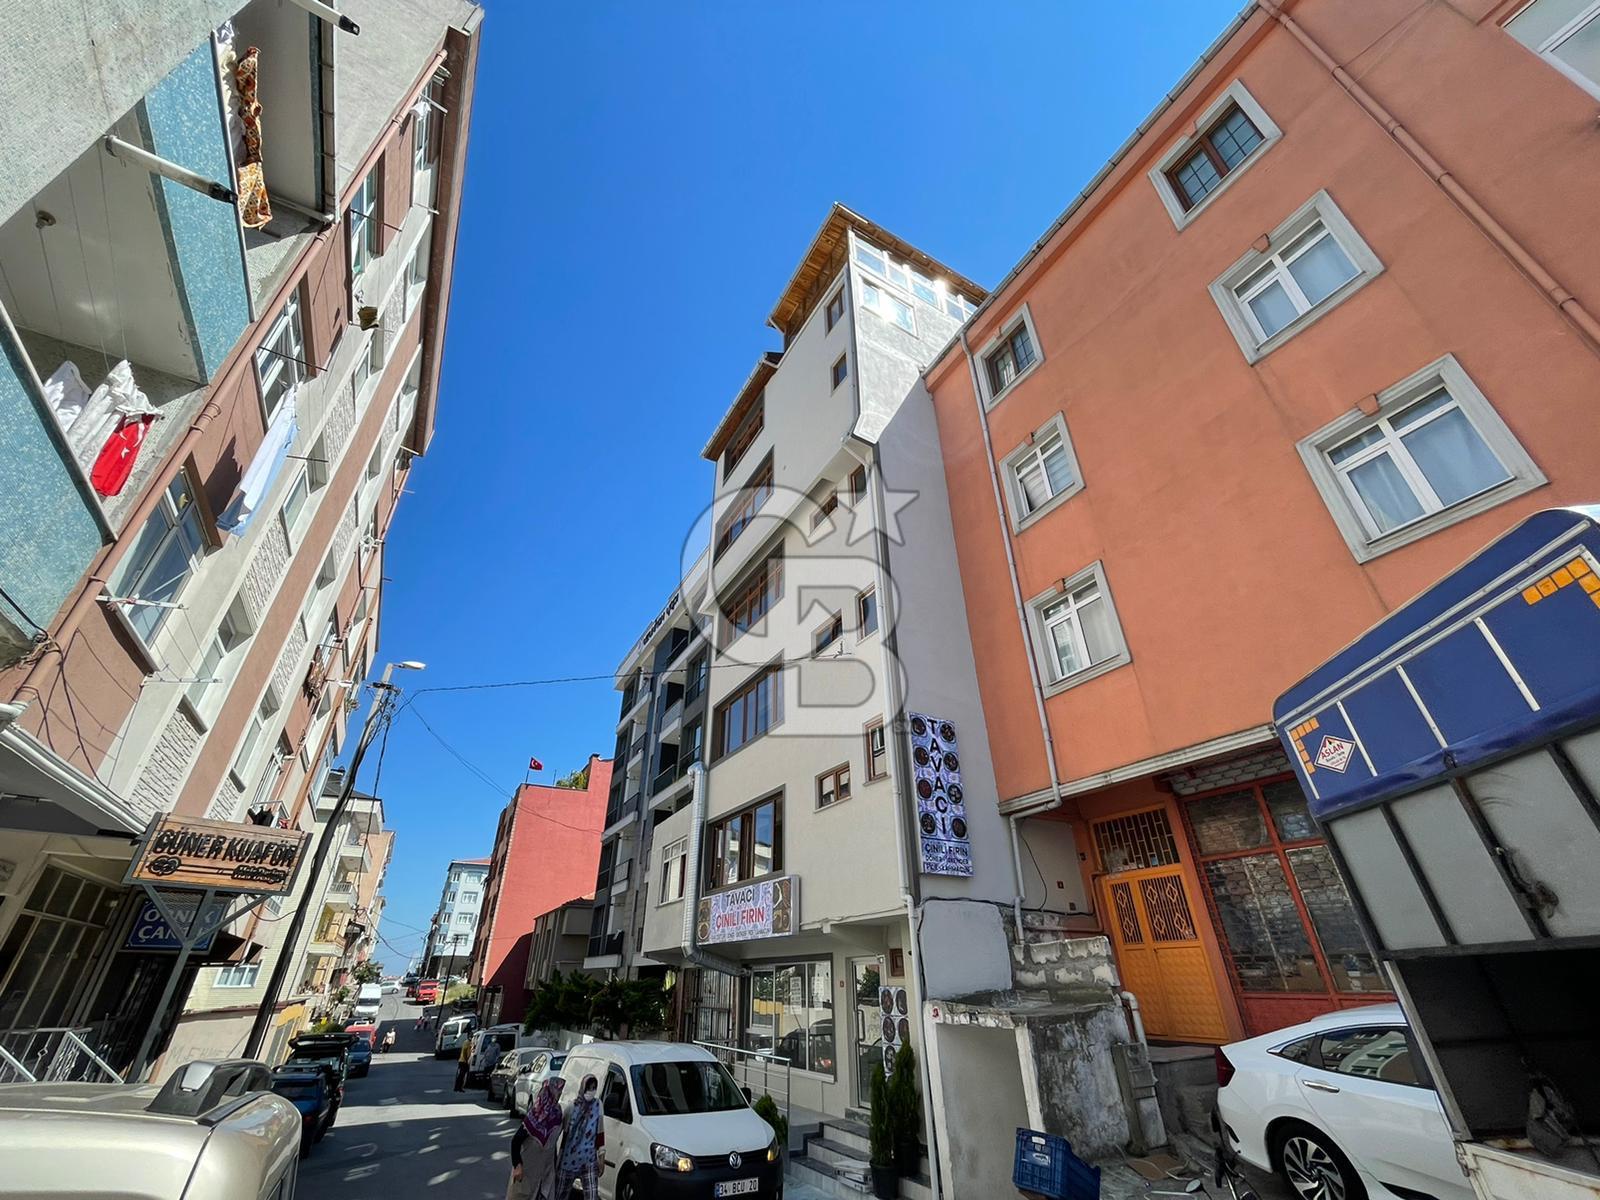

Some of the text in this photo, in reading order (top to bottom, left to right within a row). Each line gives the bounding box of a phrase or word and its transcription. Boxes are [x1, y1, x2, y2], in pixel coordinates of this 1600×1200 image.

[1321, 742, 1344, 760] ASLAN
[927, 718, 949, 835] TAVACI
[152, 826, 298, 867] GÜNER KUAFÖR
[726, 888, 755, 906] TAVACI
[741, 906, 765, 924] FIRIN
[719, 1180, 757, 1195] 34 BCU 20
